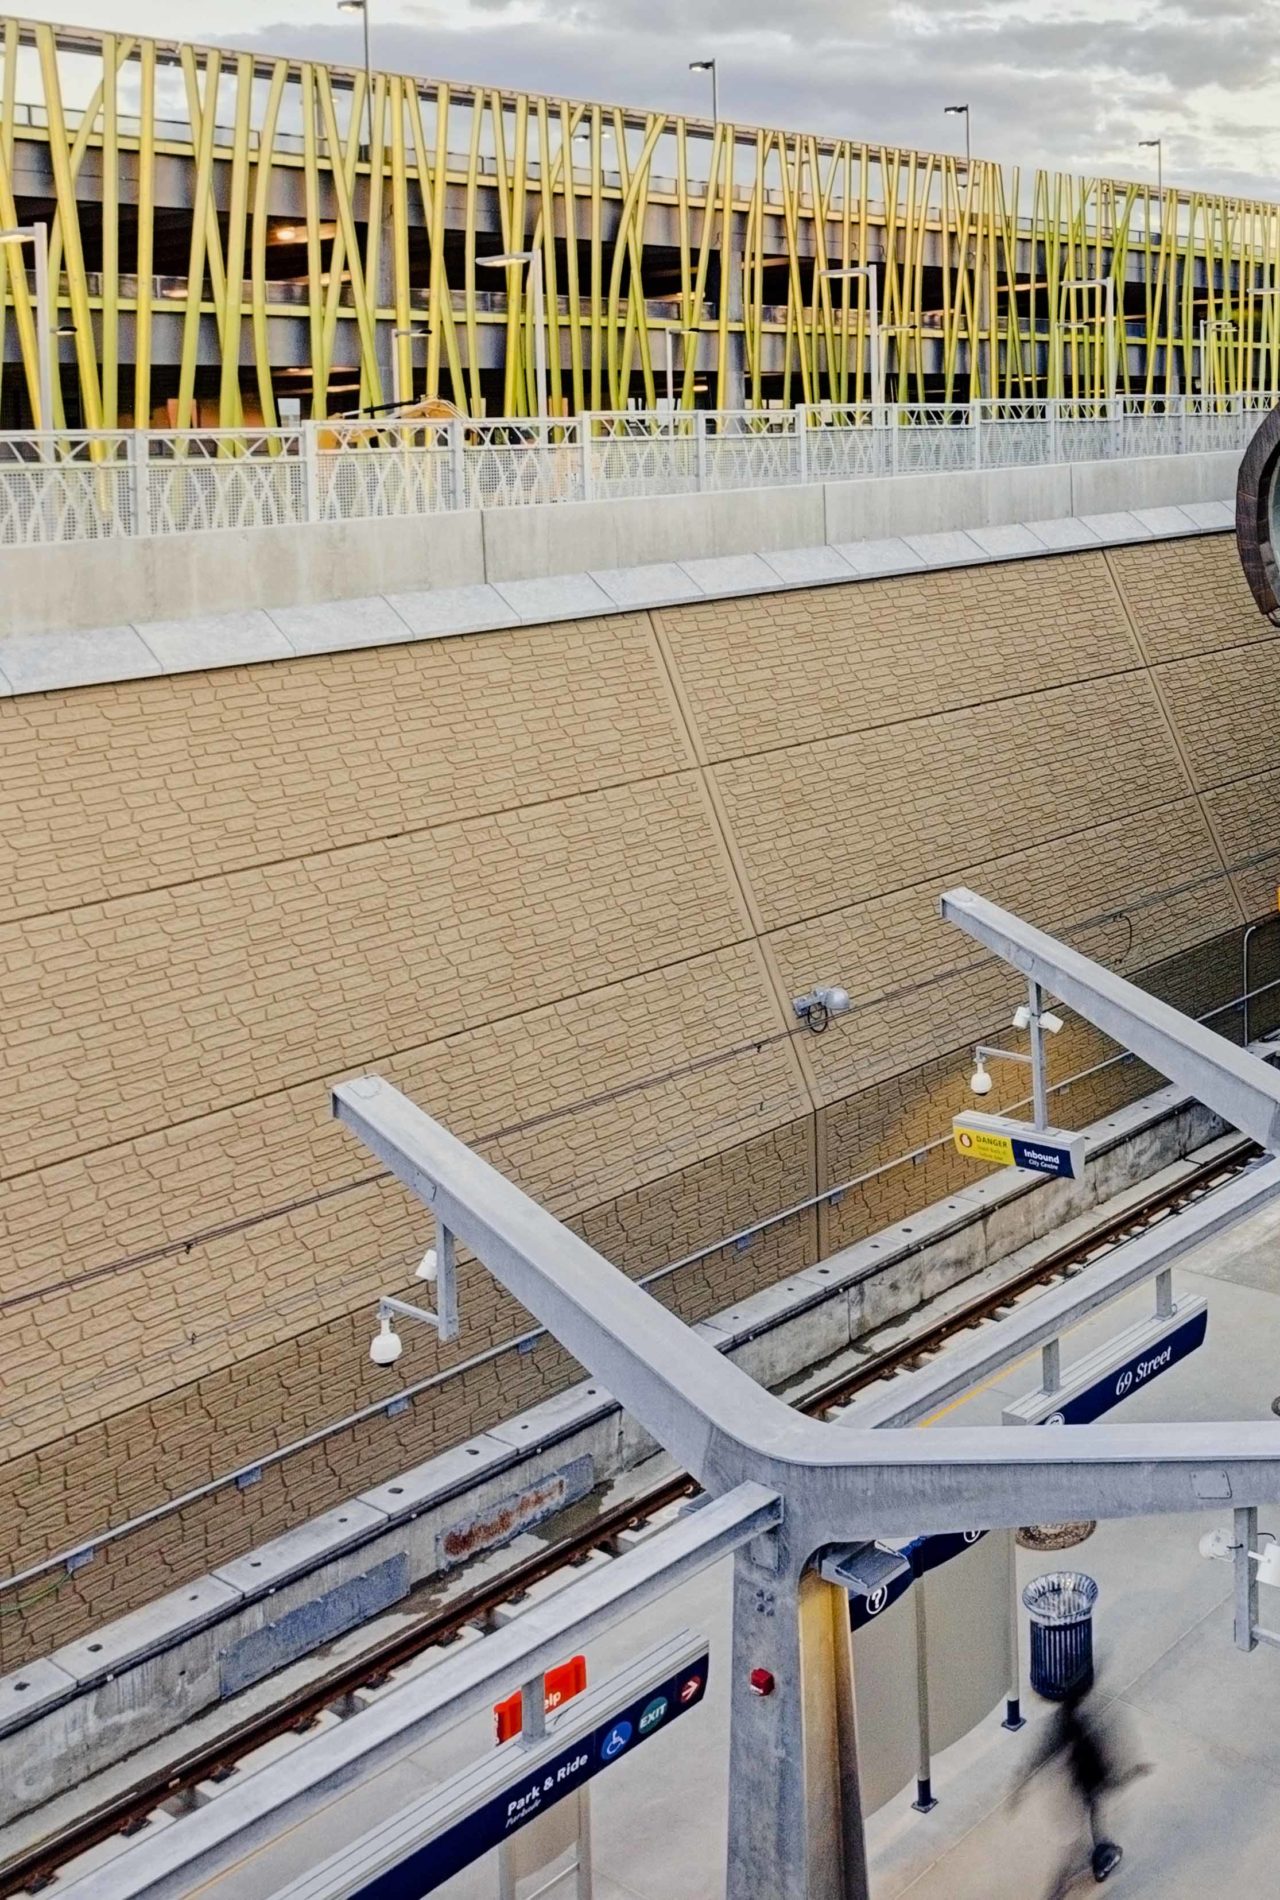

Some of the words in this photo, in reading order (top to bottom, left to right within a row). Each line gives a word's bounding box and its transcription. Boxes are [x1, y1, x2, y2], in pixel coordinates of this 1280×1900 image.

[976, 1135, 1008, 1148] DANGER
[1023, 1149, 1060, 1164] Inbound
[1028, 1158, 1039, 1168] City
[1040, 1161, 1059, 1170] Centre
[1115, 1371, 1133, 1396] 69
[1135, 1346, 1172, 1383] Street
[544, 1691, 562, 1710] elp
[639, 1702, 667, 1728] EXIT
[507, 1786, 540, 1816] Park
[543, 1777, 553, 1792] &
[557, 1754, 588, 1782] Ride
